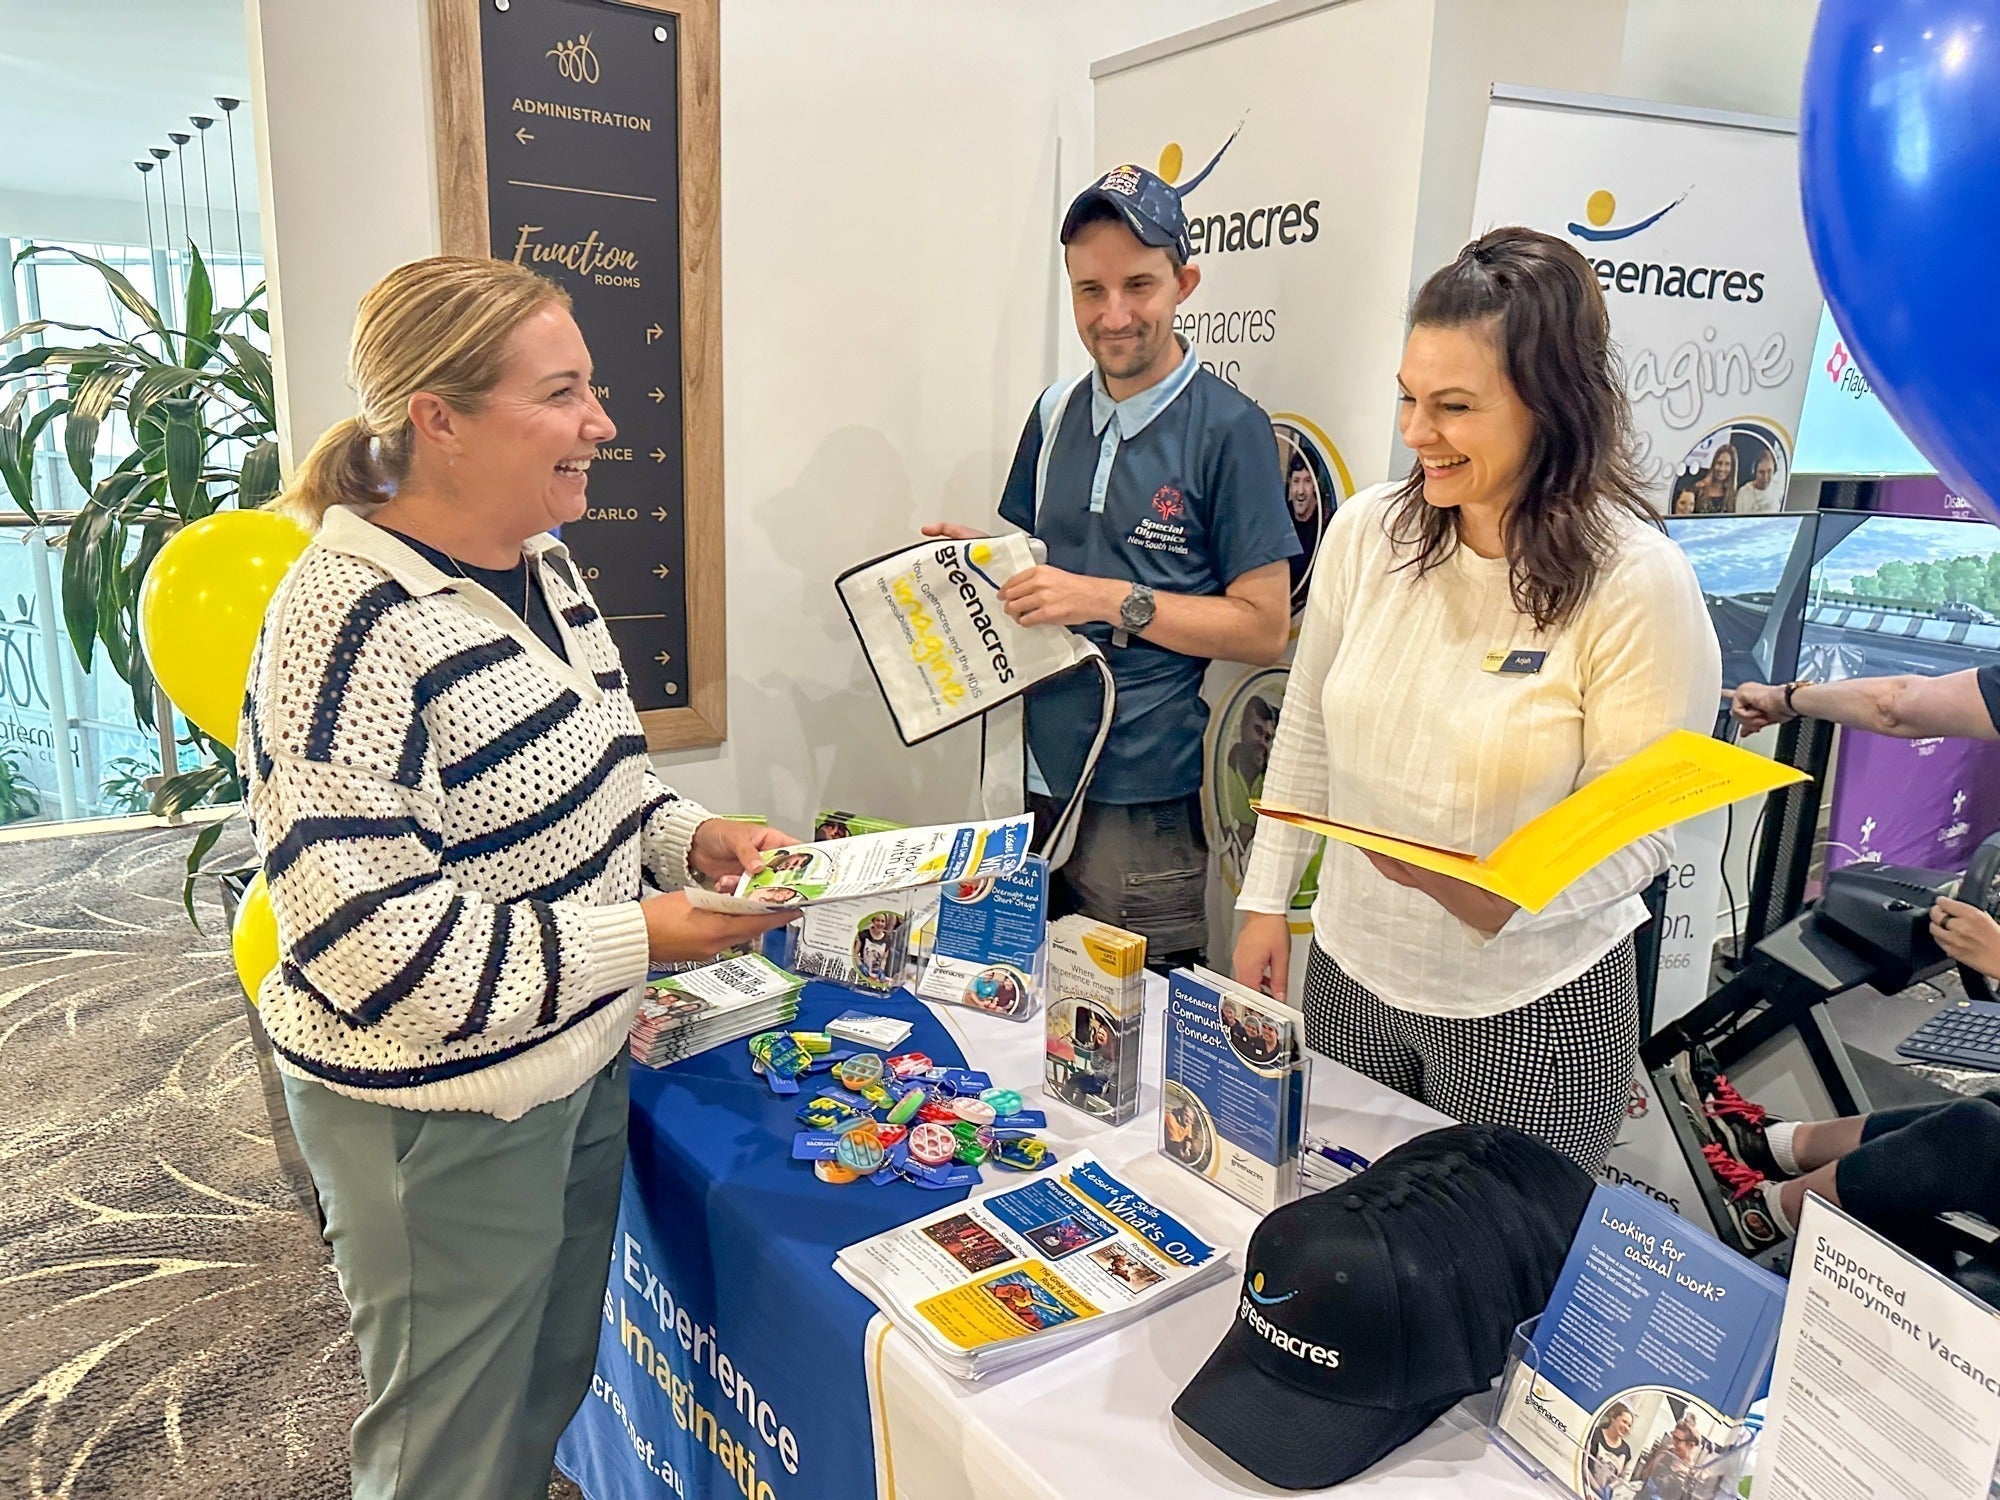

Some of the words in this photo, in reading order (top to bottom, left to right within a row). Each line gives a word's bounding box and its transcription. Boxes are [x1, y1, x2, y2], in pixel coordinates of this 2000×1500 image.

[512, 98, 651, 132] ADMINISTRATION
[512, 225, 638, 276] Function
[594, 274, 641, 288] ROOMS
[587, 508, 638, 520] CARLO
[1141, 518, 1184, 534] Special
[1127, 536, 1145, 546] New
[1145, 540, 1167, 551] South
[1168, 544, 1189, 555] Wales
[1135, 526, 1187, 543] Olympics
[877, 577, 888, 595] the
[885, 594, 915, 645] possibilities
[935, 545, 1014, 684] greenacres
[892, 572, 965, 706] imagine
[920, 583, 951, 635] Greenacres
[949, 636, 962, 654] and
[959, 655, 970, 672] the
[965, 672, 983, 699] NDIS
[889, 838, 908, 865] with
[900, 843, 925, 873] Work
[991, 886, 1025, 899] Overnight
[1026, 894, 1039, 902] and
[993, 895, 1014, 906] Short
[1014, 899, 1036, 912] Stays
[1052, 966, 1091, 985] experience
[1092, 982, 1115, 995] meets
[1071, 964, 1095, 979] Where
[1175, 988, 1218, 1012] Greenacres
[1172, 1001, 1232, 1041] Community
[1176, 1019, 1228, 1051] Connect...
[1044, 1180, 1066, 1199] Marvel
[1063, 1196, 1077, 1207] Live
[1080, 1208, 1098, 1223] Stage
[1097, 1220, 1117, 1234] Show
[1079, 1166, 1119, 1196] Leisure
[1120, 1193, 1136, 1203] &
[1132, 1200, 1161, 1219] Skills
[999, 1232, 1014, 1245] Stage
[1013, 1244, 1029, 1258] Show
[1105, 1197, 1166, 1242] What's
[1165, 1243, 1195, 1265] On
[1601, 1208, 1656, 1253] Looking
[1660, 1239, 1686, 1262] for
[1130, 1242, 1150, 1258] Rodeo
[1039, 1267, 1050, 1277] The
[1050, 1275, 1067, 1291] Great
[1065, 1288, 1095, 1312] Australian
[1040, 1278, 1056, 1293] Rock
[1624, 1246, 1673, 1279] casual
[1675, 1273, 1726, 1302] work?
[1816, 1236, 1906, 1307] Supported
[1812, 1254, 1922, 1341] Employment
[1240, 1295, 1340, 1368] greenacres
[624, 1231, 799, 1475] Experience
[1524, 1395, 1568, 1433] greenacres
